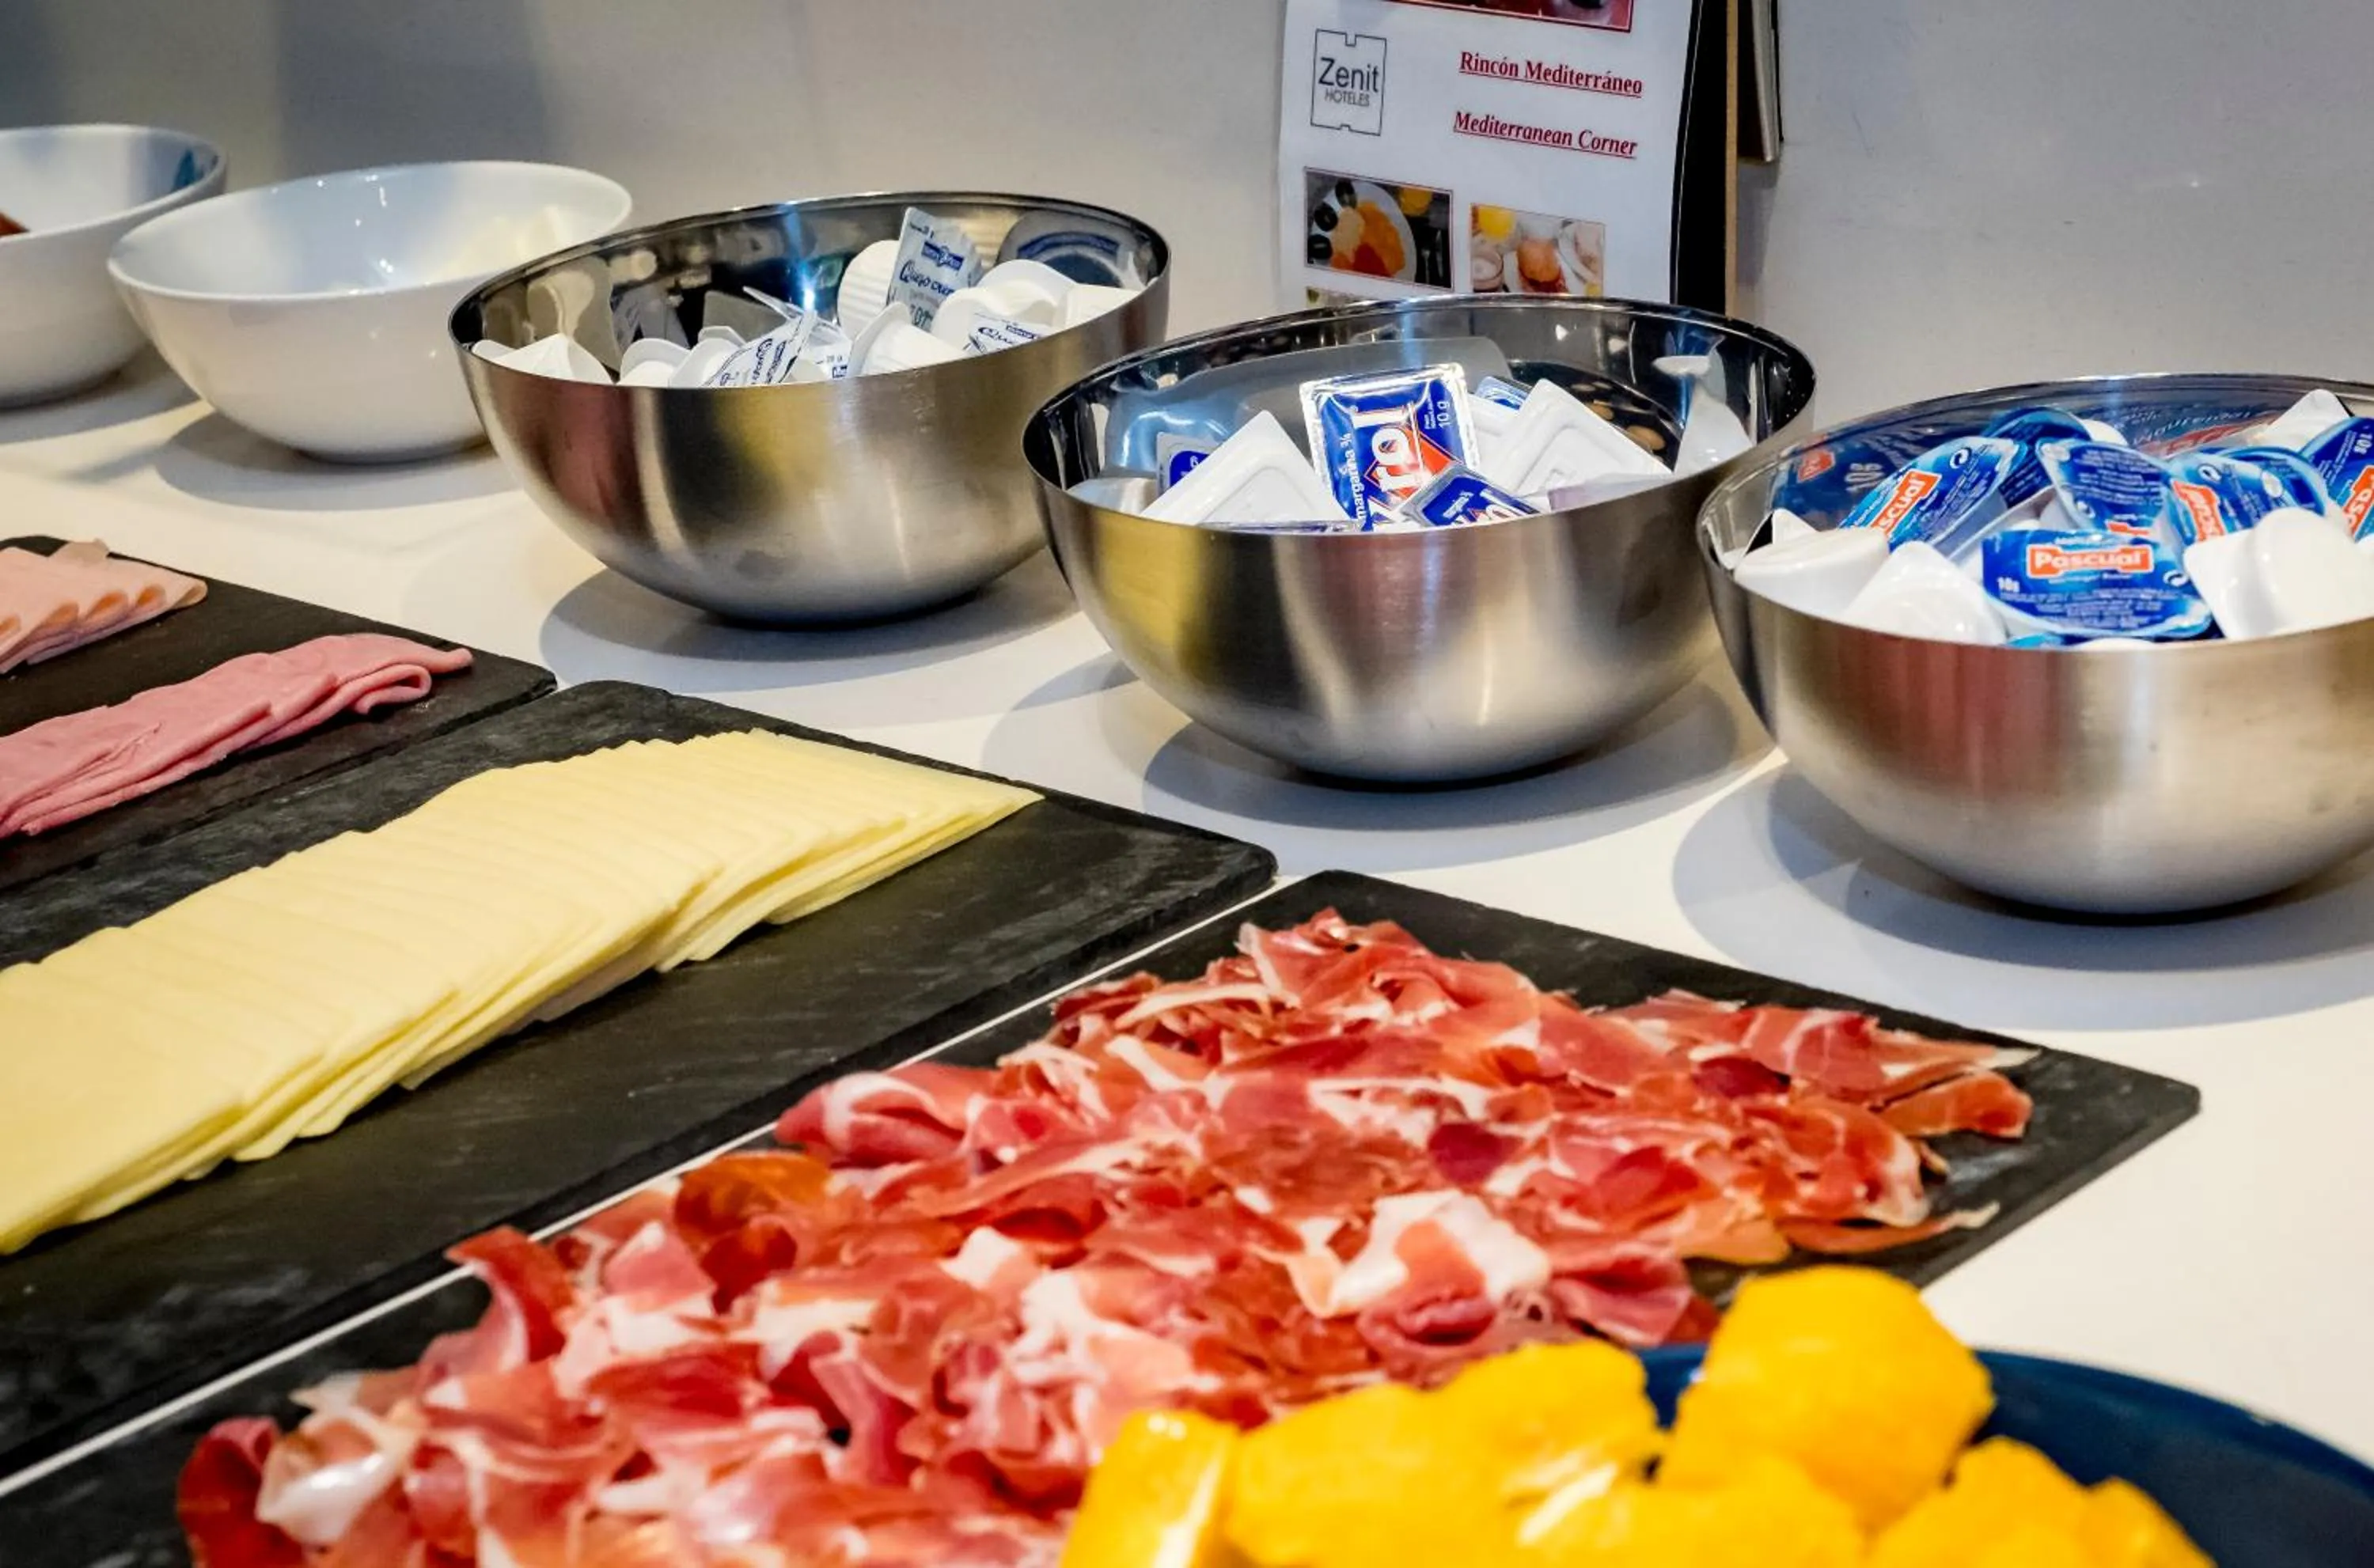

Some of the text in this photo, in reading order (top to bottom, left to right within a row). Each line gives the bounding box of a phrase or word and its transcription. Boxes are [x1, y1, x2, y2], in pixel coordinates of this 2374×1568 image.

[1318, 56, 1379, 93] Zenit
[1460, 51, 1642, 94] Rincón Mediterráneo
[1324, 88, 1370, 107] HOTELES
[1454, 110, 1638, 155] Mediterranean Corner
[1344, 450, 1367, 521] margarina
[2035, 551, 2141, 569] Pascual
